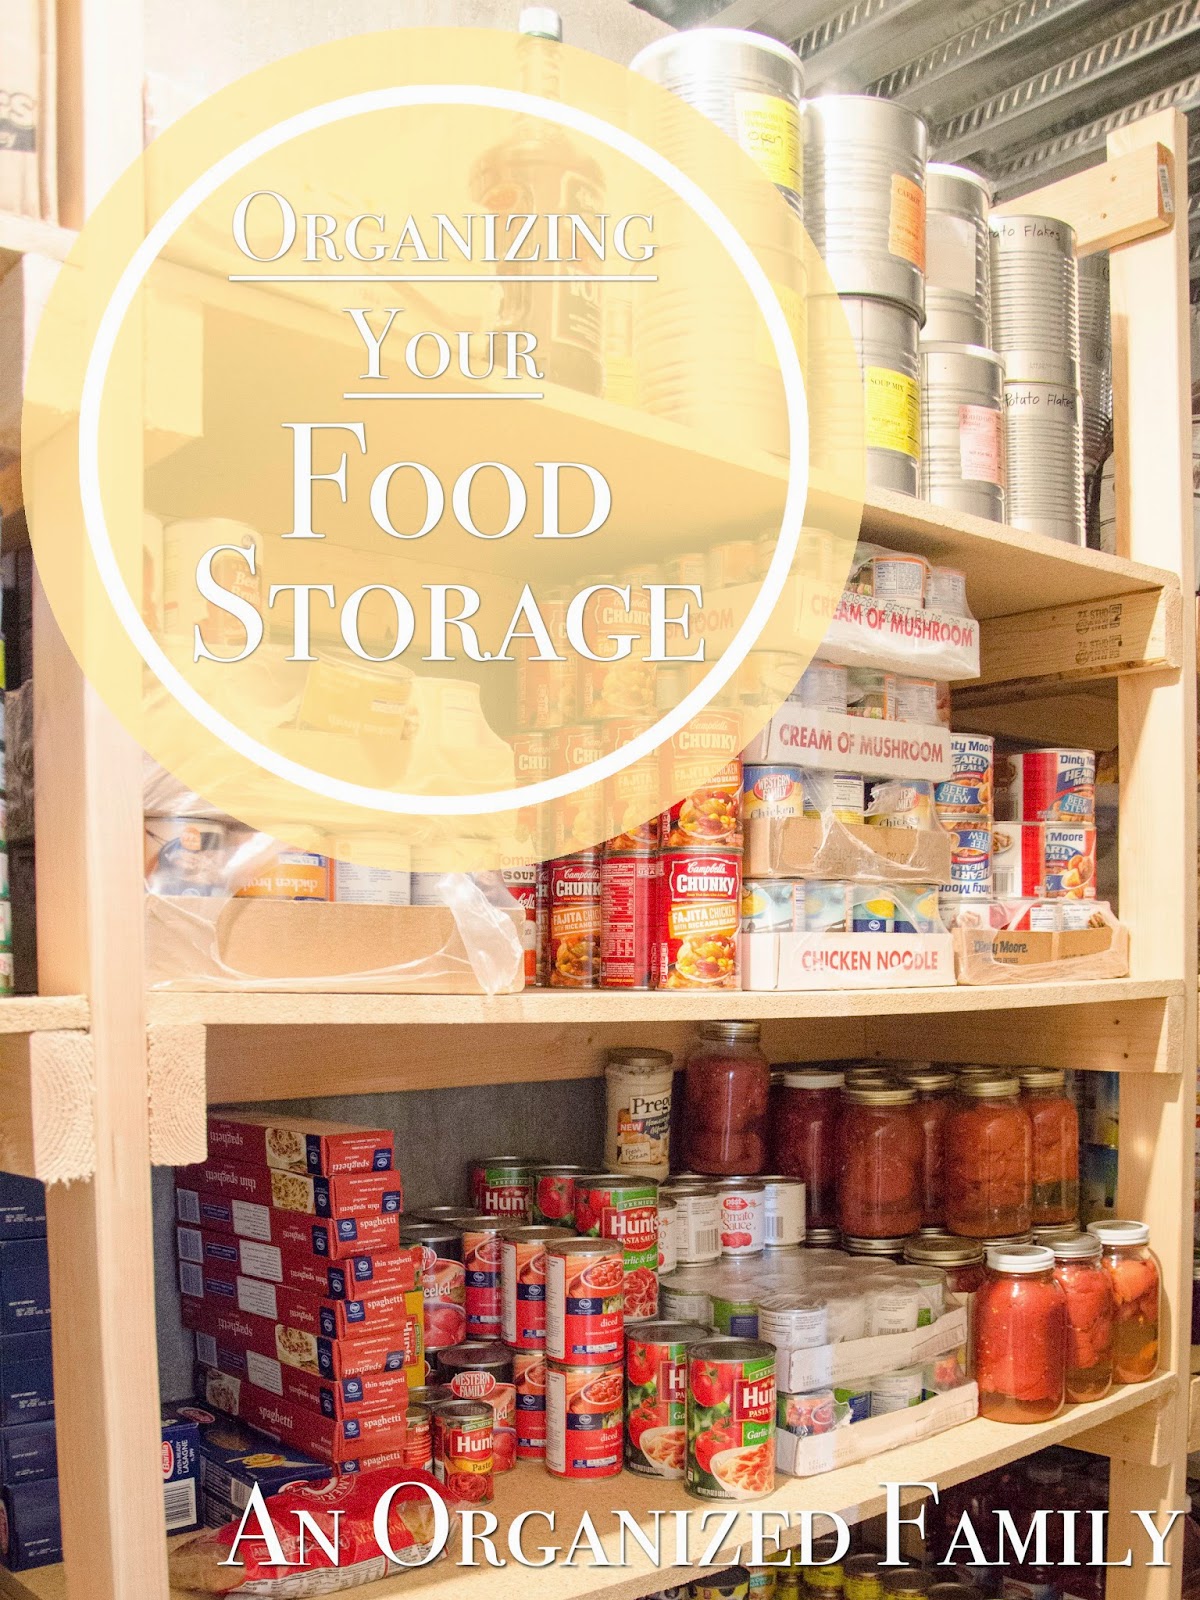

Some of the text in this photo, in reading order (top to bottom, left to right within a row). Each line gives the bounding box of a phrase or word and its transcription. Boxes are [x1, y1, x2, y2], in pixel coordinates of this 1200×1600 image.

[870, 377, 904, 393] SOUP MIX
[1004, 393, 1040, 408] Potato
[811, 594, 862, 625] CREAM
[866, 608, 886, 631] OF
[890, 612, 973, 647] MUSHROOM
[679, 731, 737, 753] CHUNKY
[779, 723, 943, 763] CREAM OF MUSHROOM
[1060, 754, 1086, 767] Dinty
[757, 773, 792, 791] WESTERN
[941, 785, 969, 796] BEEF
[937, 793, 971, 804] STEW
[1067, 793, 1088, 806] BEEF
[1063, 803, 1089, 813] STEW
[1050, 831, 1083, 841] Moore
[502, 870, 535, 881] SOUP
[275, 877, 318, 893] chicken
[676, 874, 736, 895] CHUNKY
[553, 911, 581, 926] FAJITA
[672, 906, 736, 924] FAJITA CHICKEN
[801, 950, 938, 972] CHICKEN NOODLE
[620, 1123, 642, 1132] NEW
[332, 1159, 370, 1173] spaghetti
[359, 1214, 397, 1230] spaghetti
[722, 1219, 752, 1231] Sauce
[374, 1255, 412, 1268] thin spaghetti
[423, 1281, 451, 1298] eeled
[367, 1294, 404, 1310] spaghetti
[600, 1316, 618, 1328] diced
[344, 1362, 383, 1378] spaghetti
[364, 1376, 405, 1389] thin spaghetti
[455, 1371, 491, 1386] WESTERN
[459, 1383, 486, 1398] FAMILY
[258, 1404, 294, 1429] spaghetti
[748, 1407, 770, 1418] PASTA
[363, 1413, 402, 1429] spaghetti
[600, 1431, 618, 1442] diced
[362, 1451, 401, 1468] spaghetti
[473, 1461, 491, 1472] Paste
